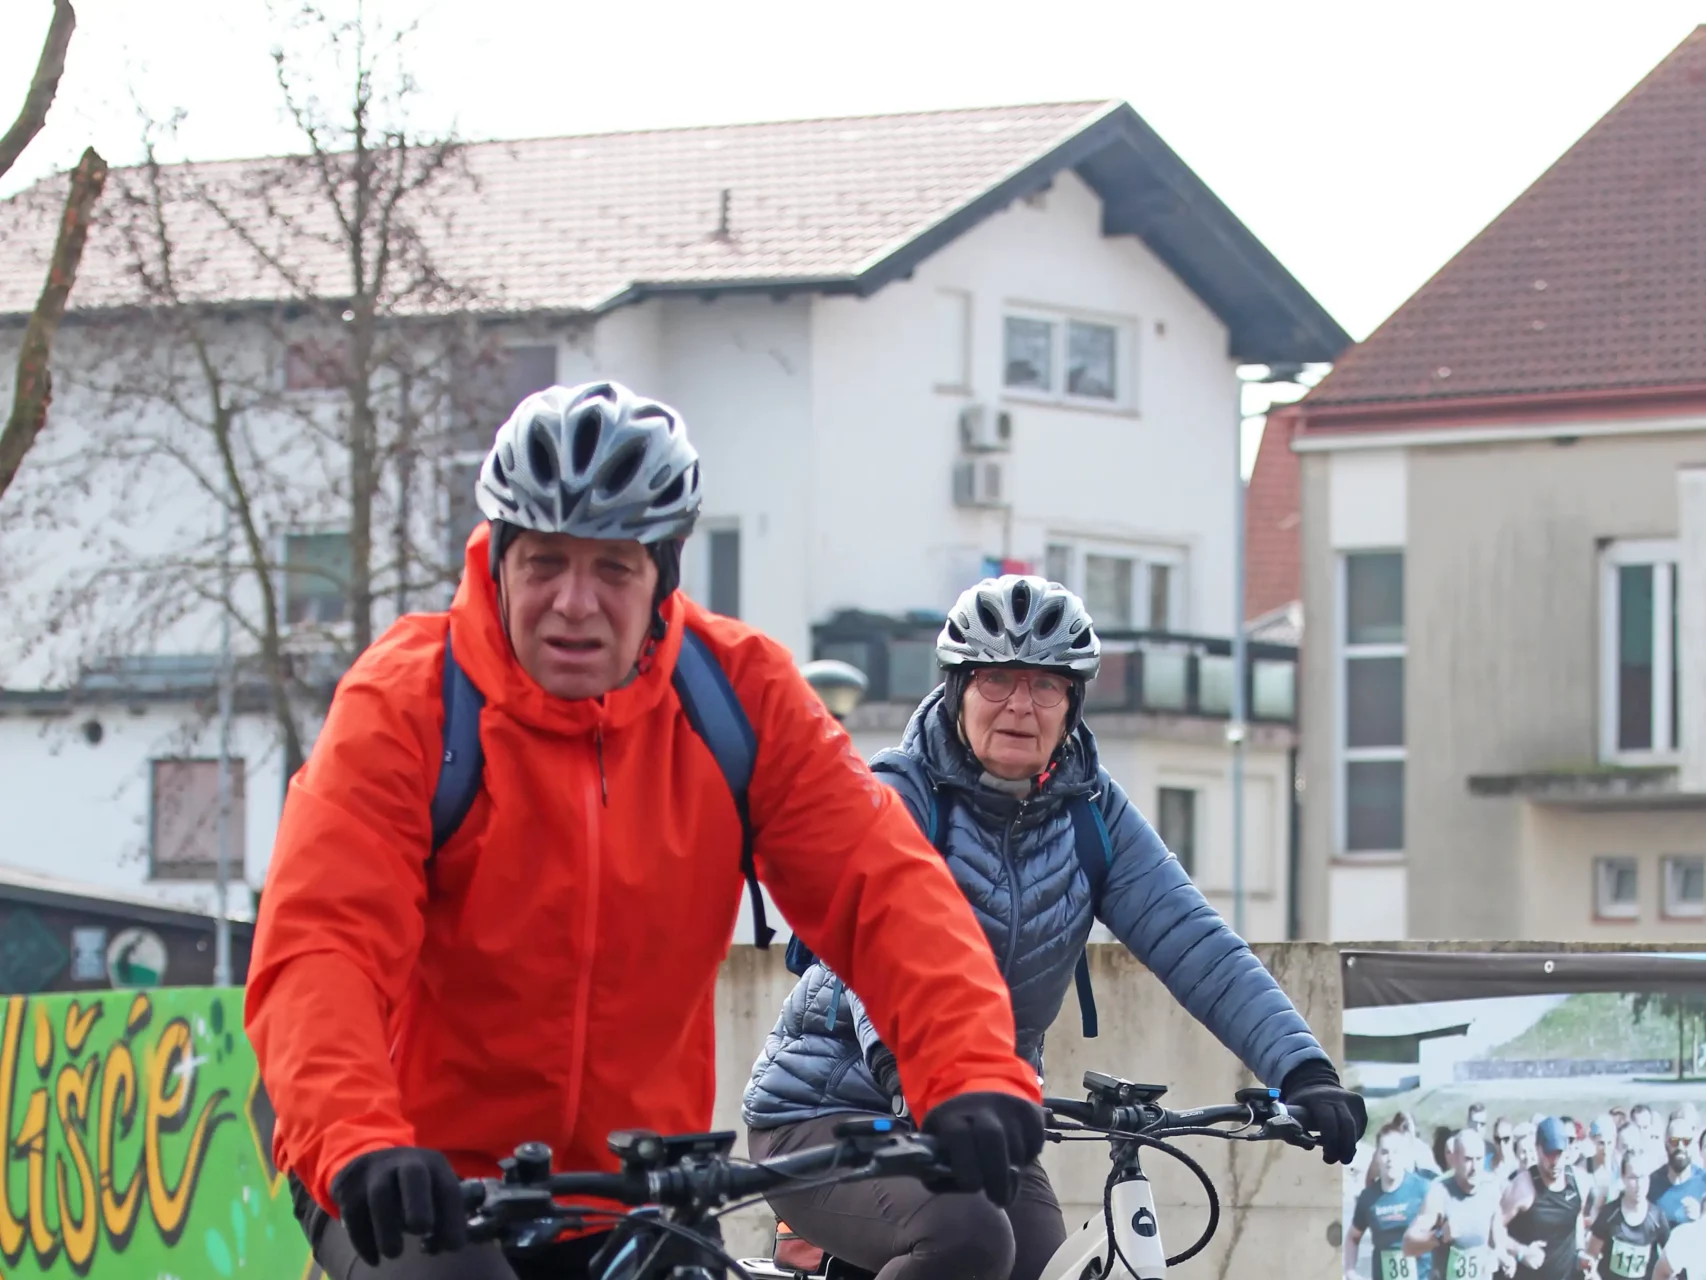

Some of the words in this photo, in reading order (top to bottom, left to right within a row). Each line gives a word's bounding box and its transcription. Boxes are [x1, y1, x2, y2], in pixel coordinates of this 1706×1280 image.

[1389, 1258, 1409, 1279] 38
[1456, 1256, 1477, 1278] 35
[1616, 1251, 1646, 1273] 117
